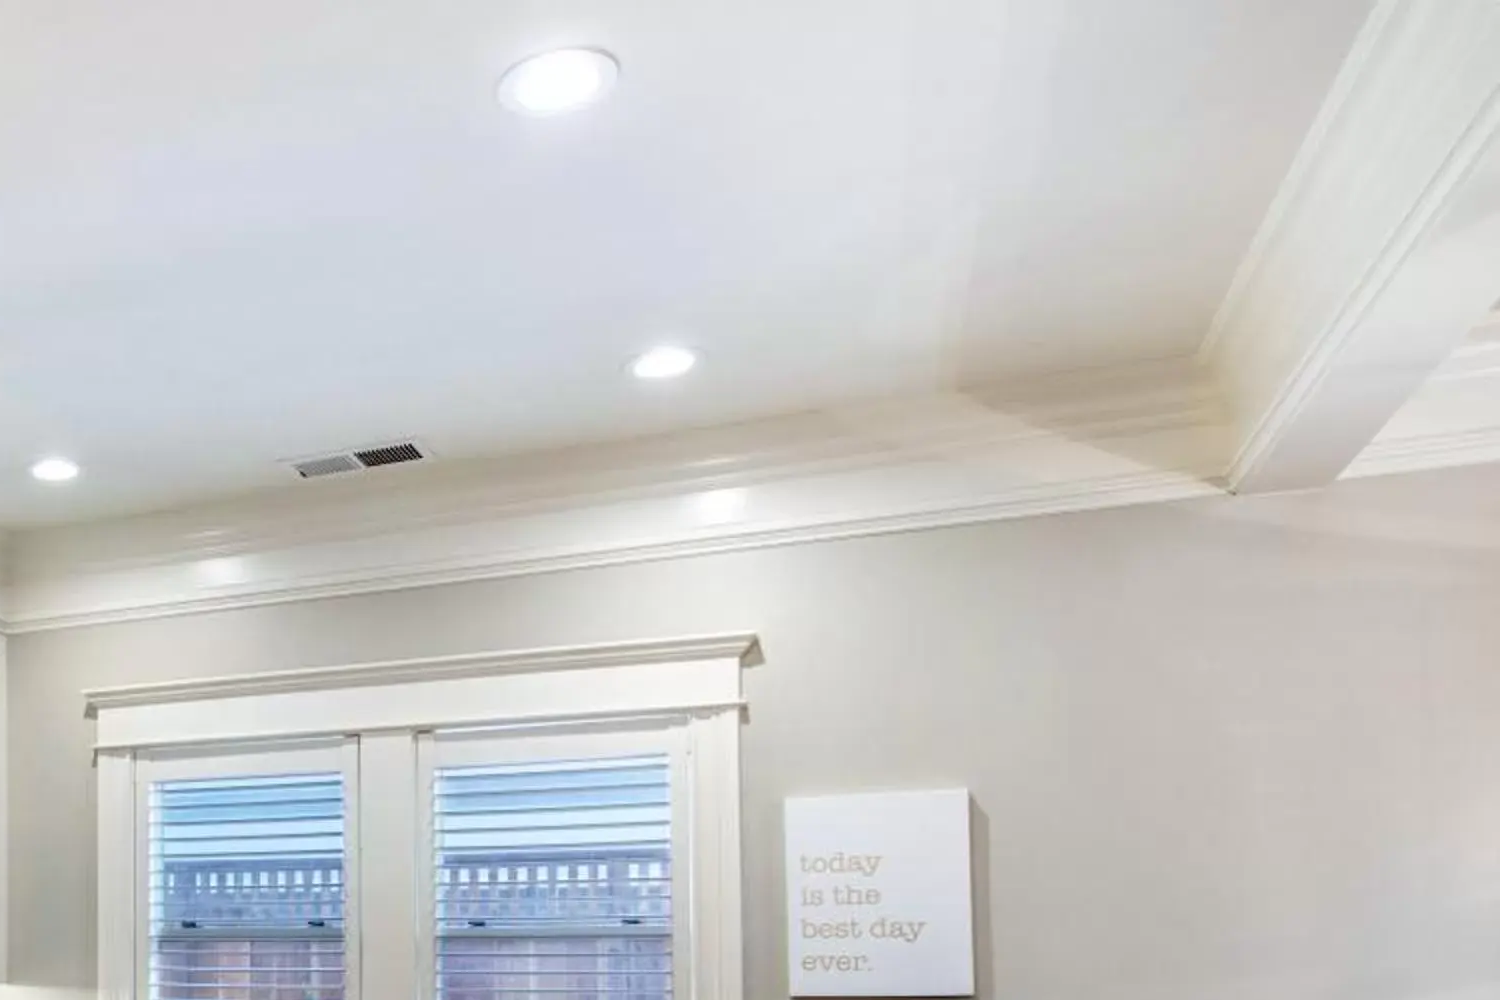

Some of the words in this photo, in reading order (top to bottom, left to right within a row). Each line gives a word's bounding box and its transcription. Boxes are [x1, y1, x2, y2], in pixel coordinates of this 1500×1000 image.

[800, 852, 883, 877] today
[801, 885, 823, 907] is
[832, 885, 881, 906] the
[801, 918, 862, 940] best
[869, 917, 927, 943] day
[802, 954, 874, 972] ever.
